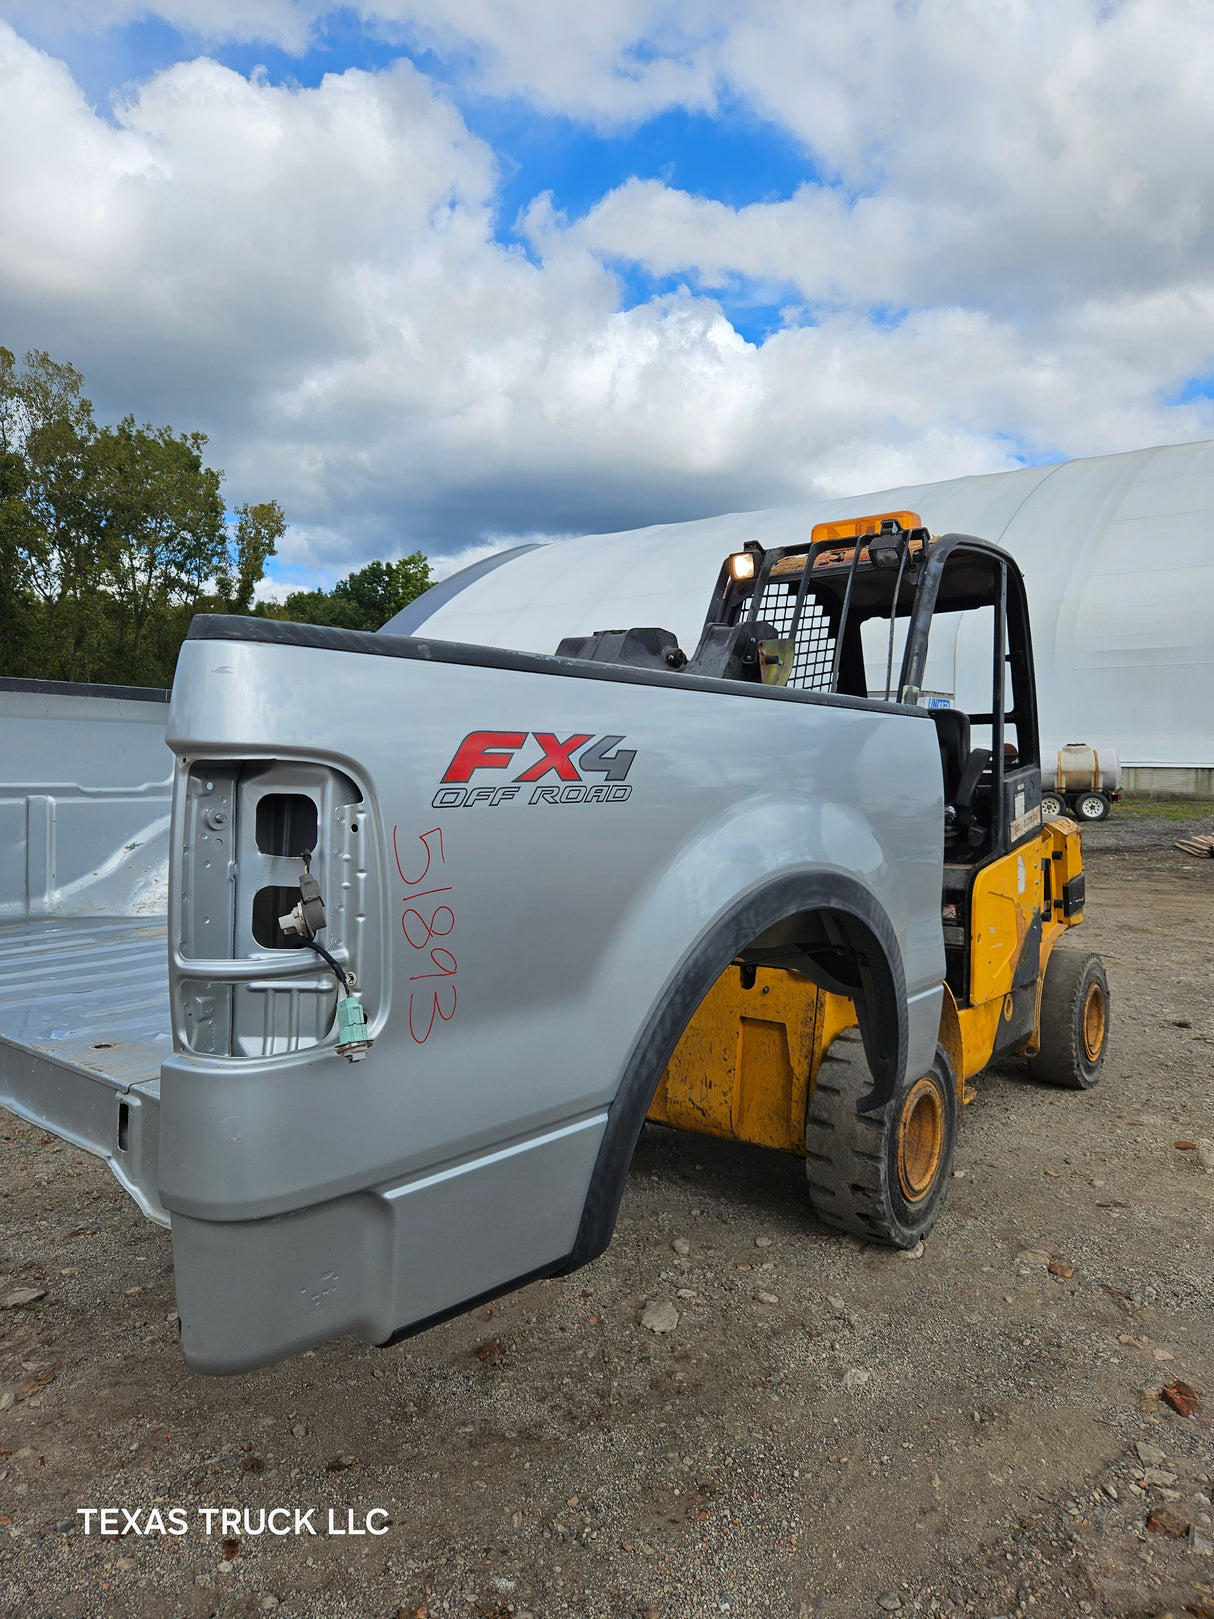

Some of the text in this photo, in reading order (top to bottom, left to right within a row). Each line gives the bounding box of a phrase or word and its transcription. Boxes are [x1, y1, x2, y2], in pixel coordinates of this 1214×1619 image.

[440, 730, 637, 783] FX4
[431, 785, 633, 809] OFF ROAD
[393, 825, 458, 1044] 51893
